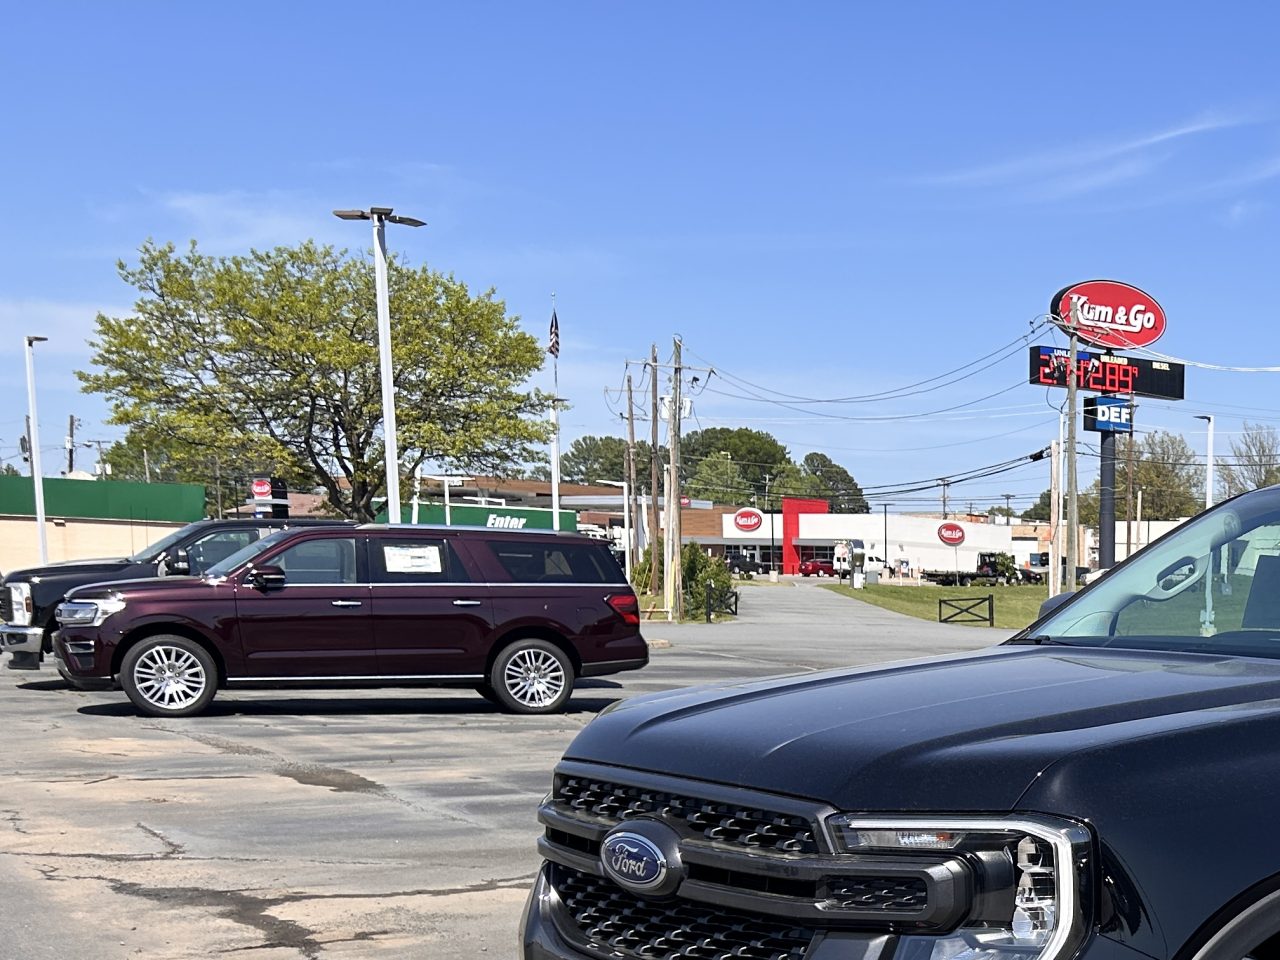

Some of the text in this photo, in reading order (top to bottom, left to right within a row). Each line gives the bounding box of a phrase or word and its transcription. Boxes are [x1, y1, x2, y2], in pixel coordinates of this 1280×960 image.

[1069, 294, 1155, 333] Kum & Go
[1097, 404, 1131, 424] DEF
[486, 514, 527, 529] Enter
[612, 843, 647, 877] Ford
